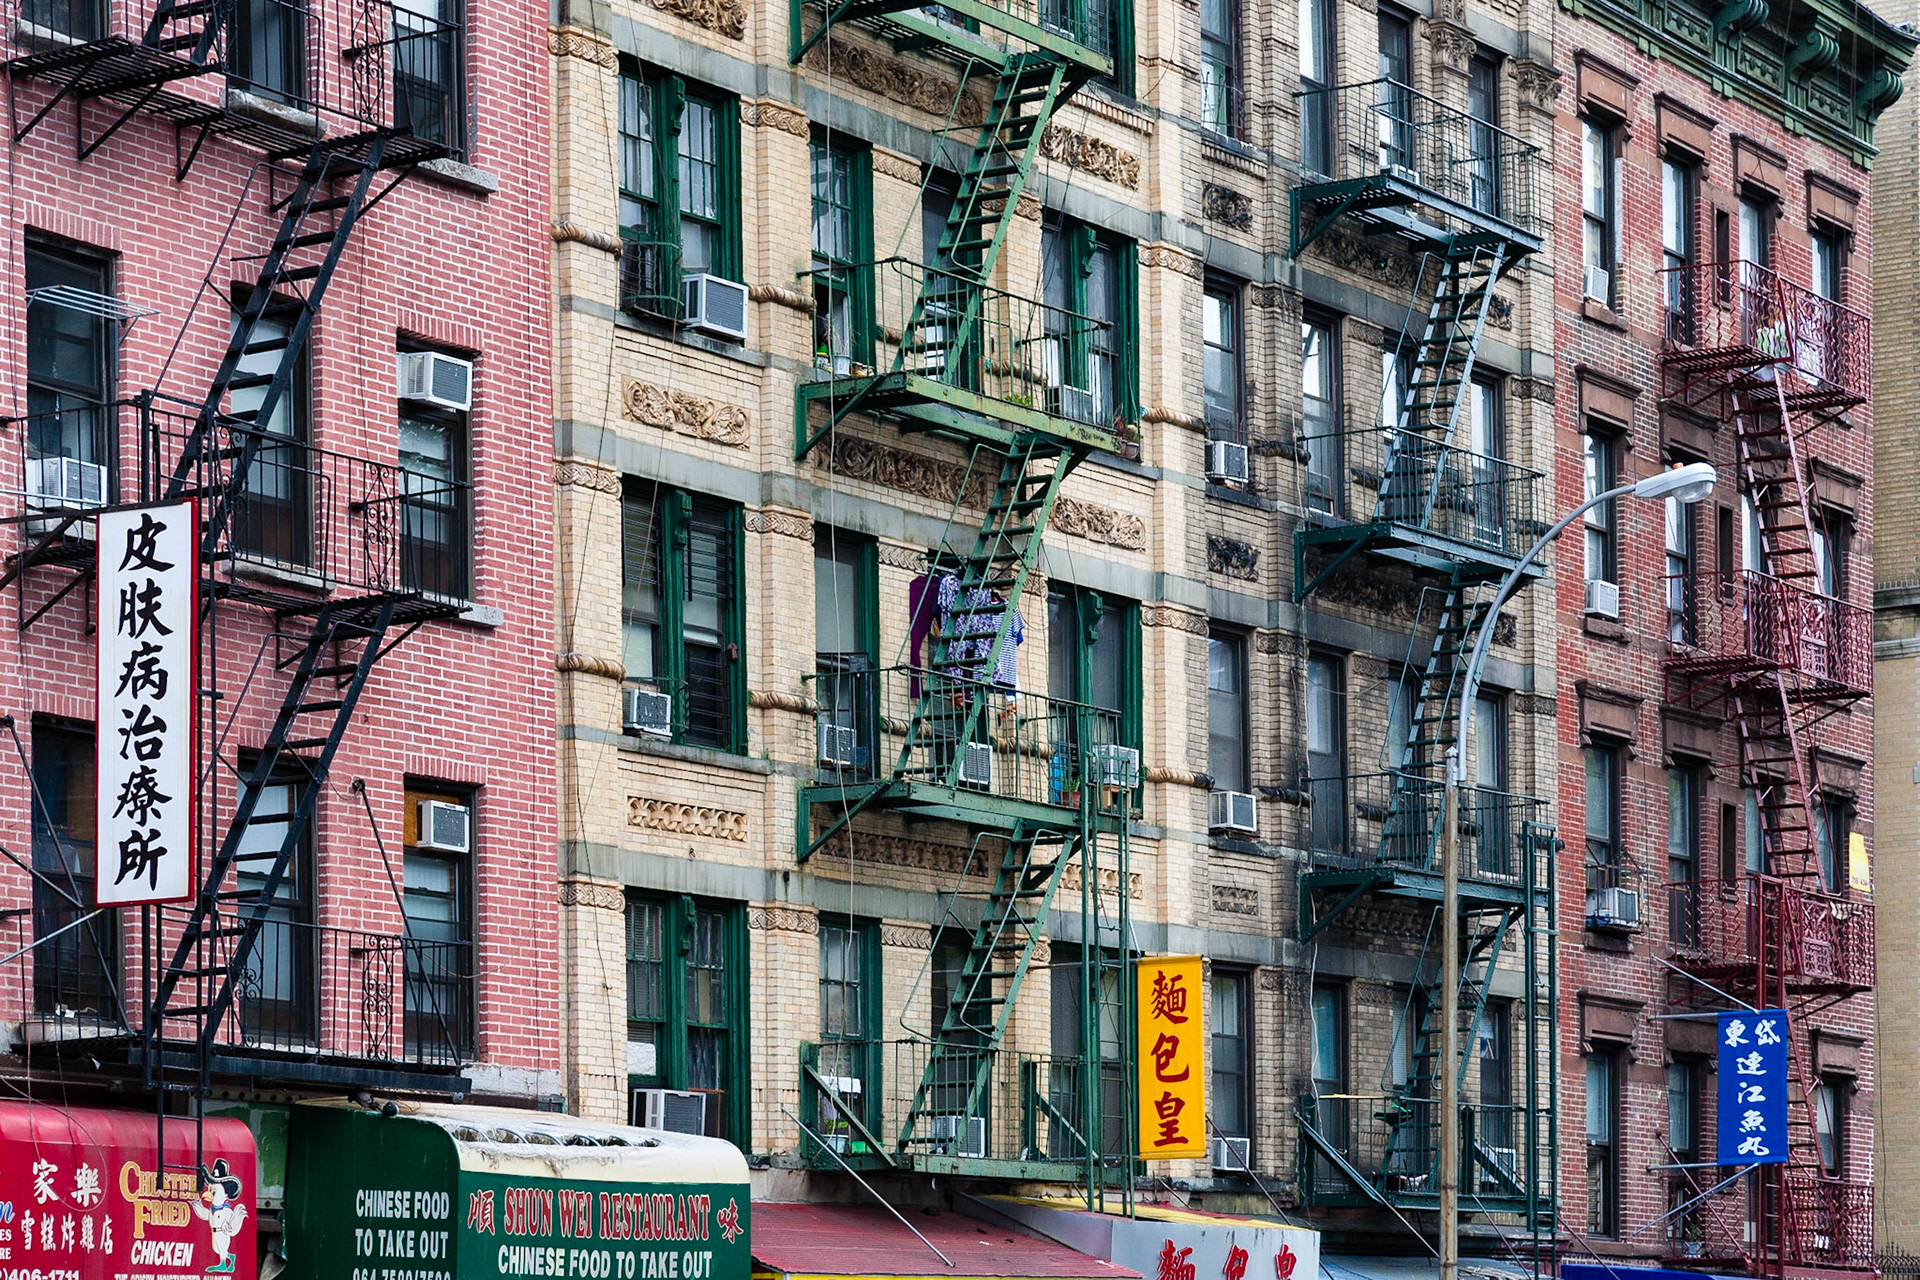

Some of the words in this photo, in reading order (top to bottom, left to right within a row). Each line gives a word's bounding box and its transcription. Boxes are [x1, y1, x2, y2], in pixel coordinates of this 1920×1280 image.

[113, 513, 175, 891] 皮肤病治療所
[1150, 970, 1190, 1147] 麵包皇
[1736, 1051, 1770, 1156] 連江魚丸
[32, 1157, 102, 1208] 家樂
[356, 1189, 411, 1219] CHINESE
[414, 1191, 450, 1220] FOOD
[132, 1199, 191, 1239] FRIED
[467, 1188, 496, 1236] 順
[503, 1186, 554, 1237] SHUN
[558, 1188, 593, 1239] WEI
[599, 1191, 711, 1241] RESTAURANT
[716, 1196, 745, 1244] 味
[130, 1240, 194, 1267] CHICKEN
[355, 1228, 374, 1257] TO
[378, 1229, 416, 1258] TAKE
[419, 1230, 449, 1259] OUT
[498, 1244, 566, 1277] CHINESE
[568, 1248, 612, 1279] FOOD
[615, 1250, 636, 1280] TO
[640, 1251, 679, 1279] TAKE
[682, 1251, 713, 1279] OUT
